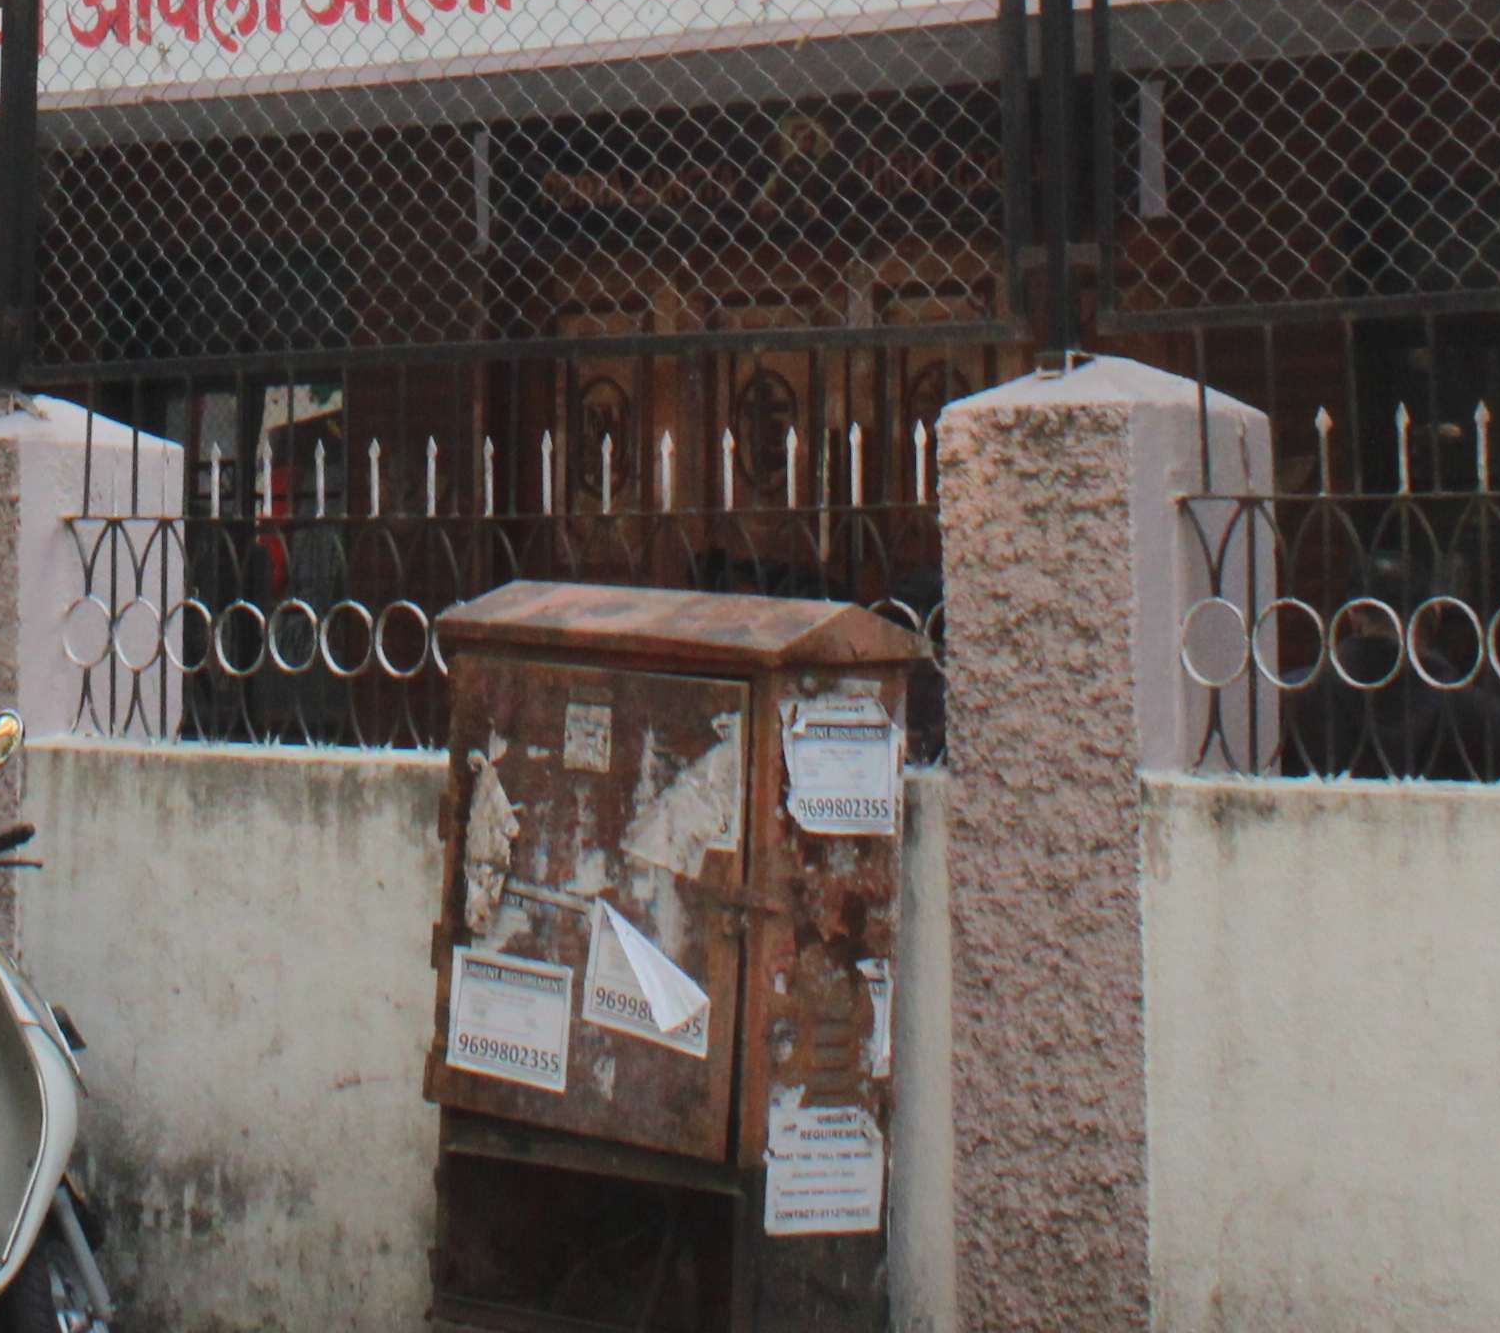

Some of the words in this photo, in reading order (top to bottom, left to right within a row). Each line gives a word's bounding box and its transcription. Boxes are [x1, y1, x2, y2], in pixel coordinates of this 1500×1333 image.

[799, 797, 888, 819] 9699802355
[595, 986, 702, 1037] 9699855
[458, 1032, 560, 1073] 9699802355
[800, 1129, 867, 1140] REQUIREMEN
